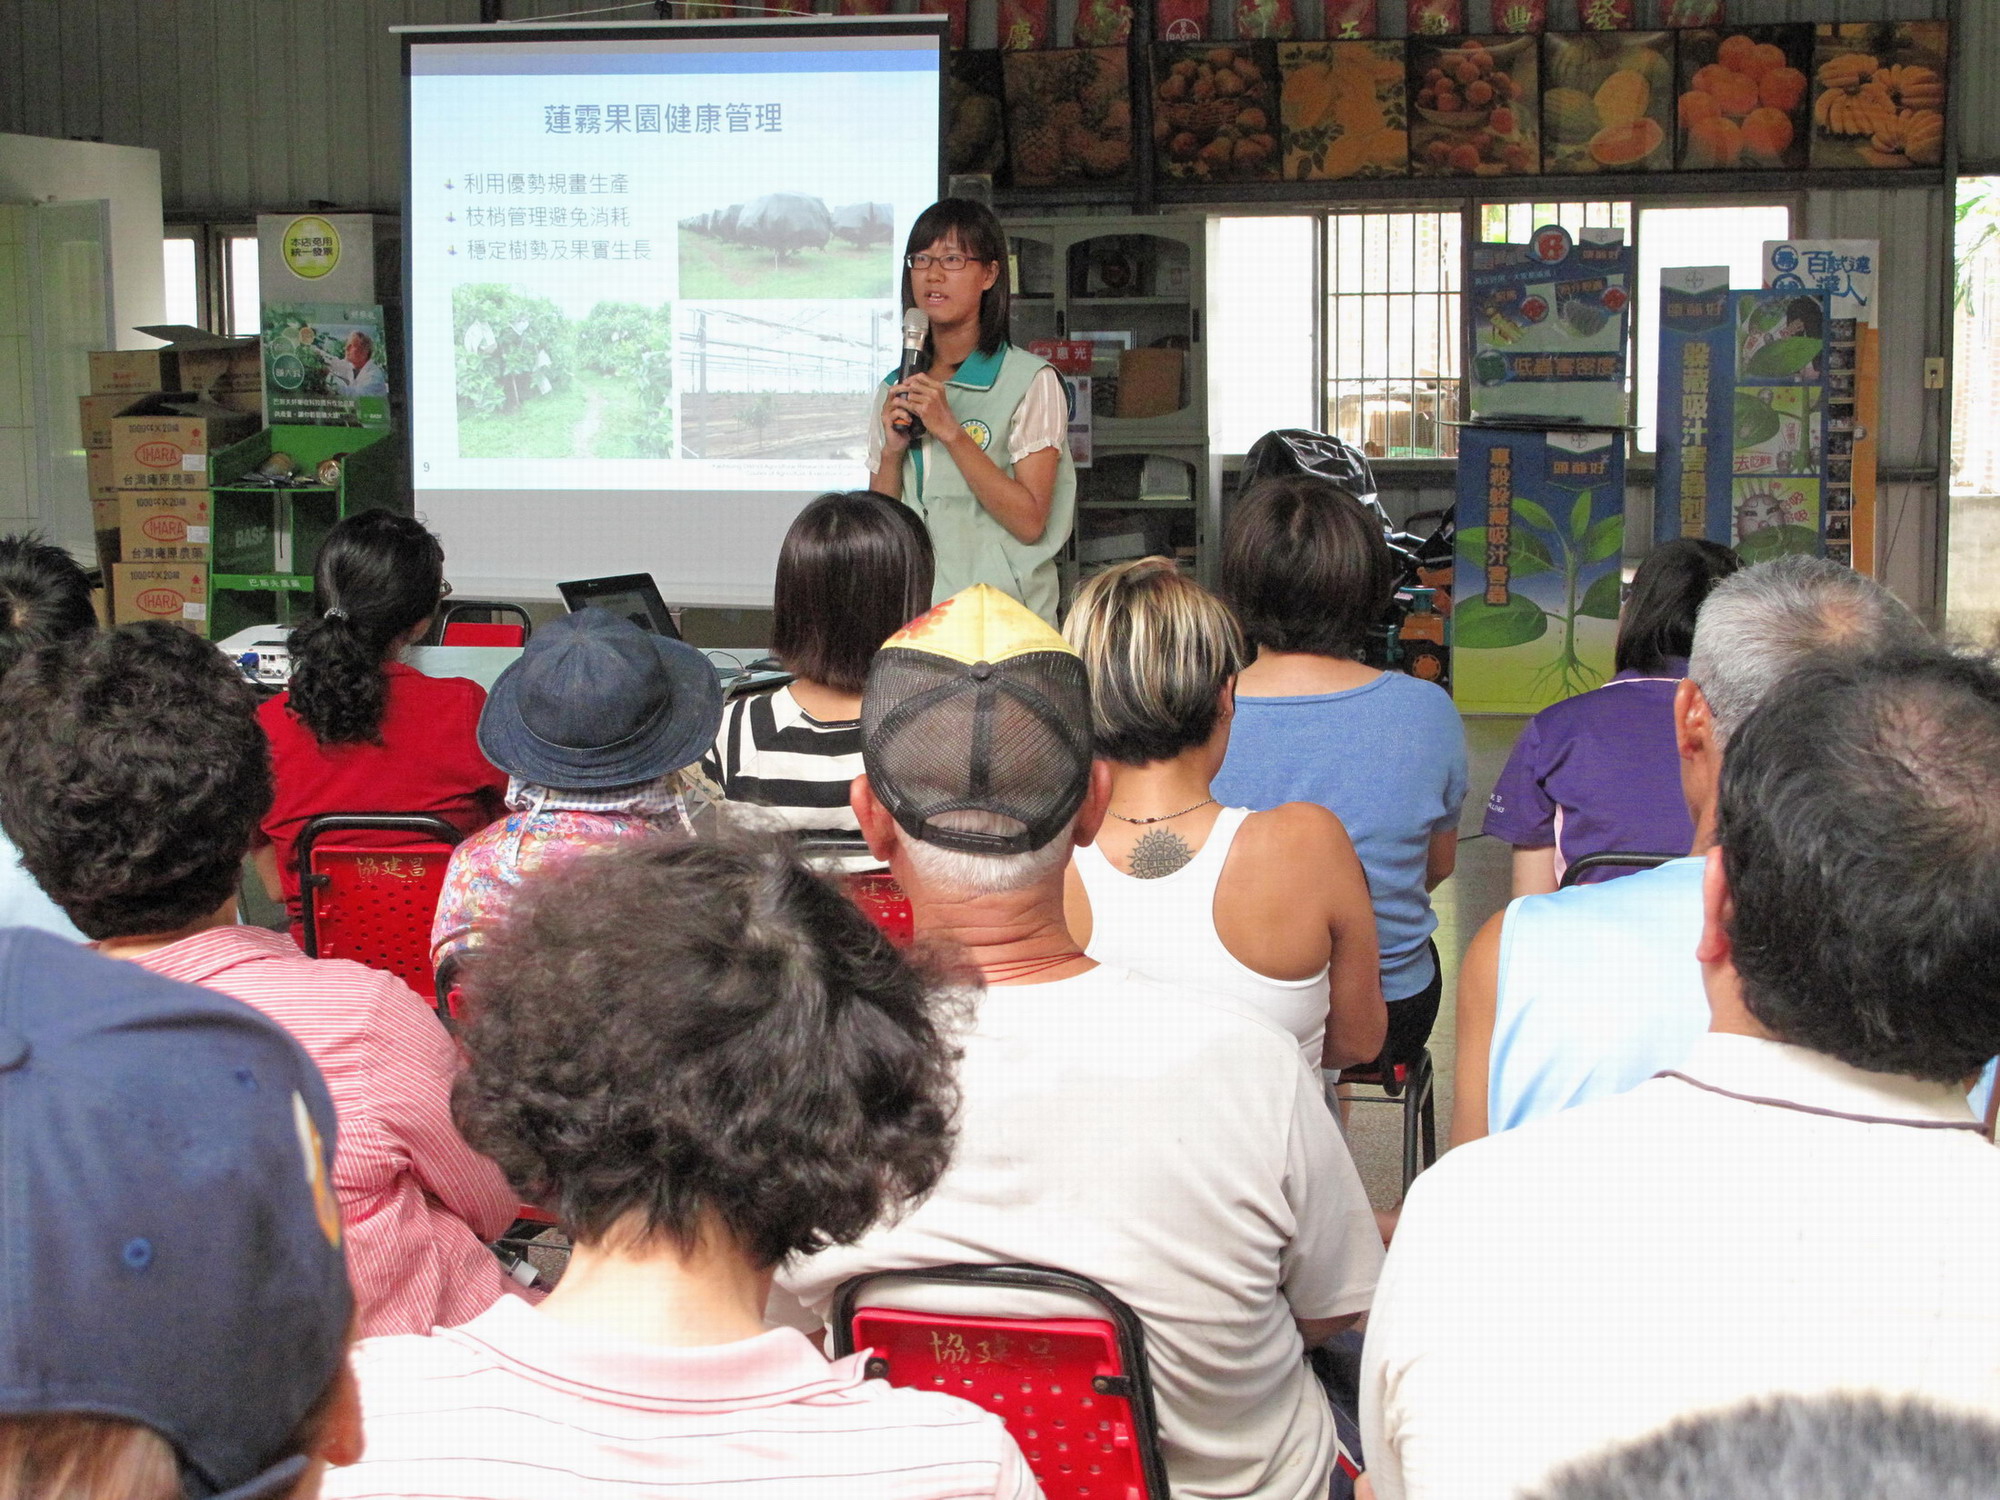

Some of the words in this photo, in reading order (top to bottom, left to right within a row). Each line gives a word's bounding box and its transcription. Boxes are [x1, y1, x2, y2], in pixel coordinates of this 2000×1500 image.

[544, 102, 783, 134] 蓮霧果園健康管理
[464, 173, 629, 195] 利用優勢規畫生產
[466, 205, 631, 228] 枝梢管理避免消耗
[467, 239, 652, 260] 穩定樹勢及果實生長
[142, 447, 177, 462] IHARA
[422, 461, 431, 473] 9
[149, 520, 184, 536] IHARA
[144, 594, 178, 609] IHARA
